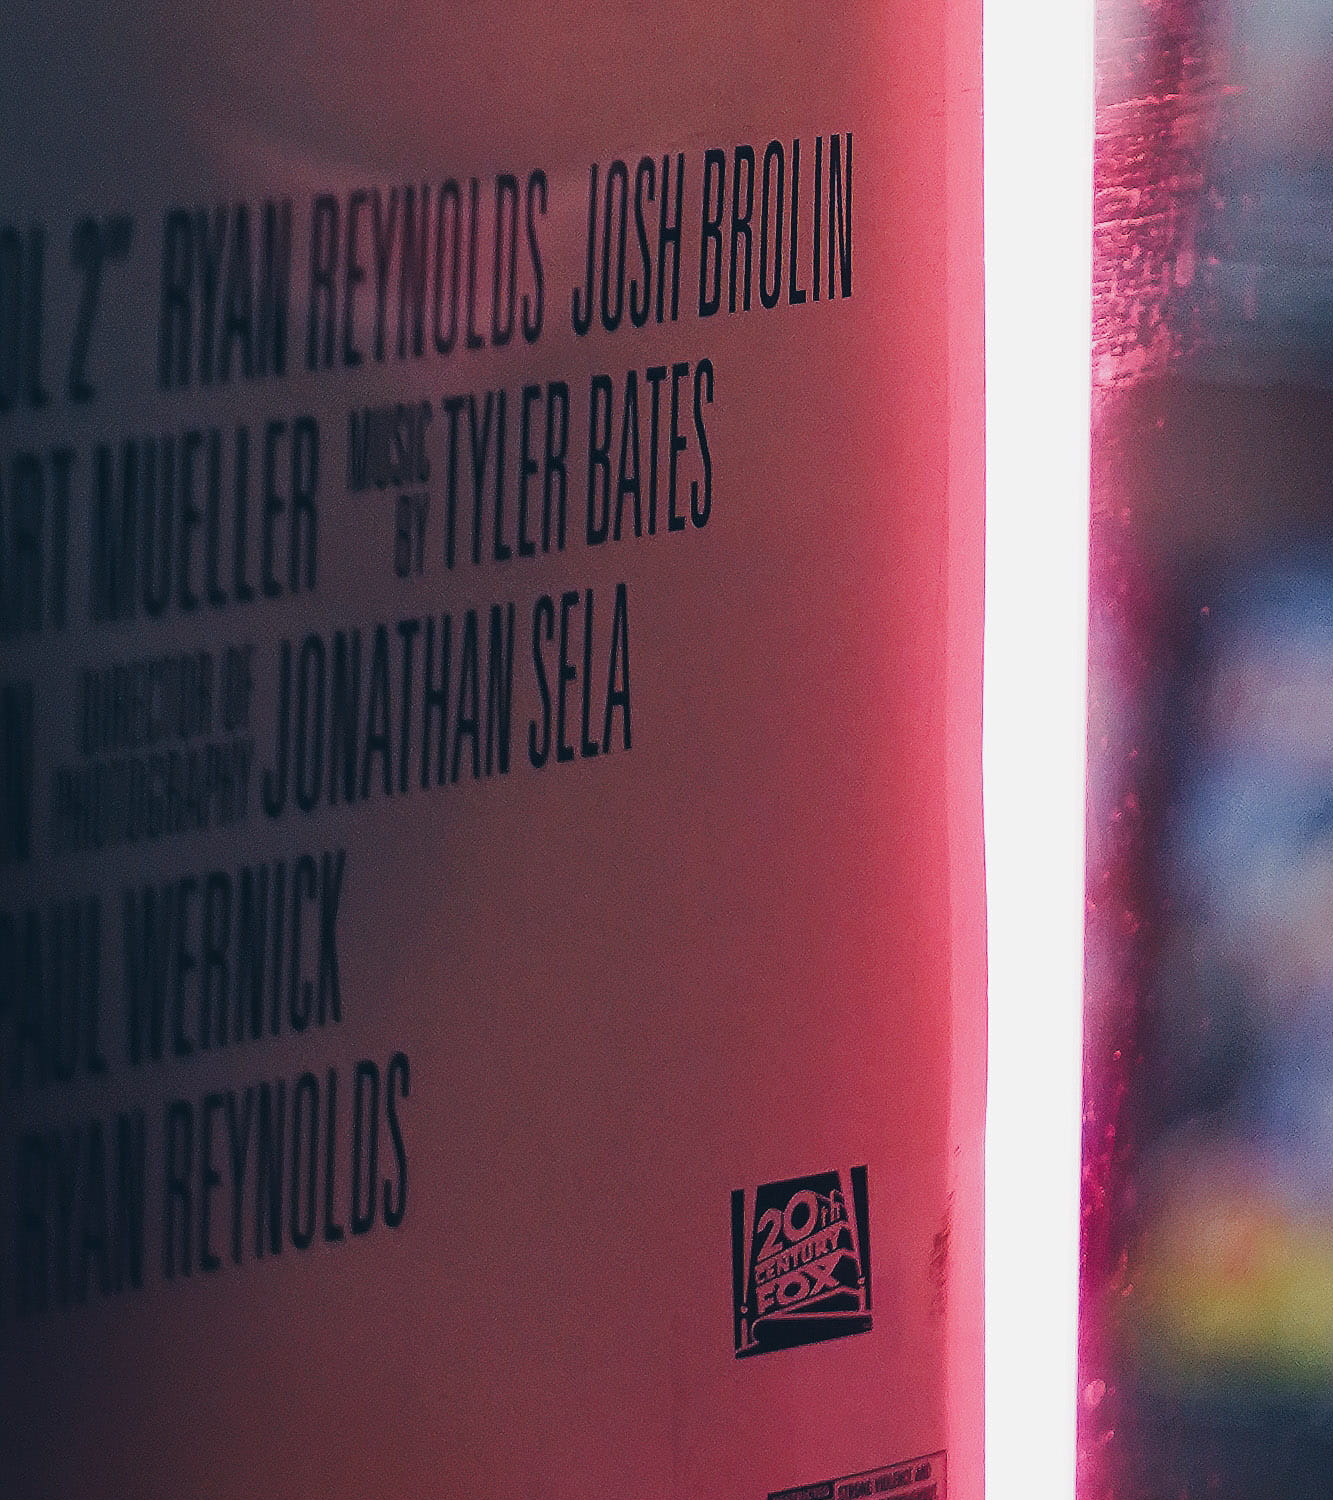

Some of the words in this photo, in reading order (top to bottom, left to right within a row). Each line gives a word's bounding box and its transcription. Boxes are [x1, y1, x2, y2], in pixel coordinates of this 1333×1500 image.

[157, 198, 292, 392] RYAN
[308, 168, 549, 371] REYNOLDS
[571, 153, 685, 337] JOSH
[697, 131, 854, 319] BROLIN
[89, 415, 320, 626] MUELLER
[443, 380, 570, 570] TYLER
[585, 357, 715, 546] BATES
[260, 601, 513, 819] JONATHAN
[528, 582, 633, 769] SELA
[122, 848, 347, 1067] WERNICK
[163, 1050, 412, 1280] REYNOLDS
[754, 1223, 842, 1284] CENTURY
[755, 1249, 842, 1316] FOX
